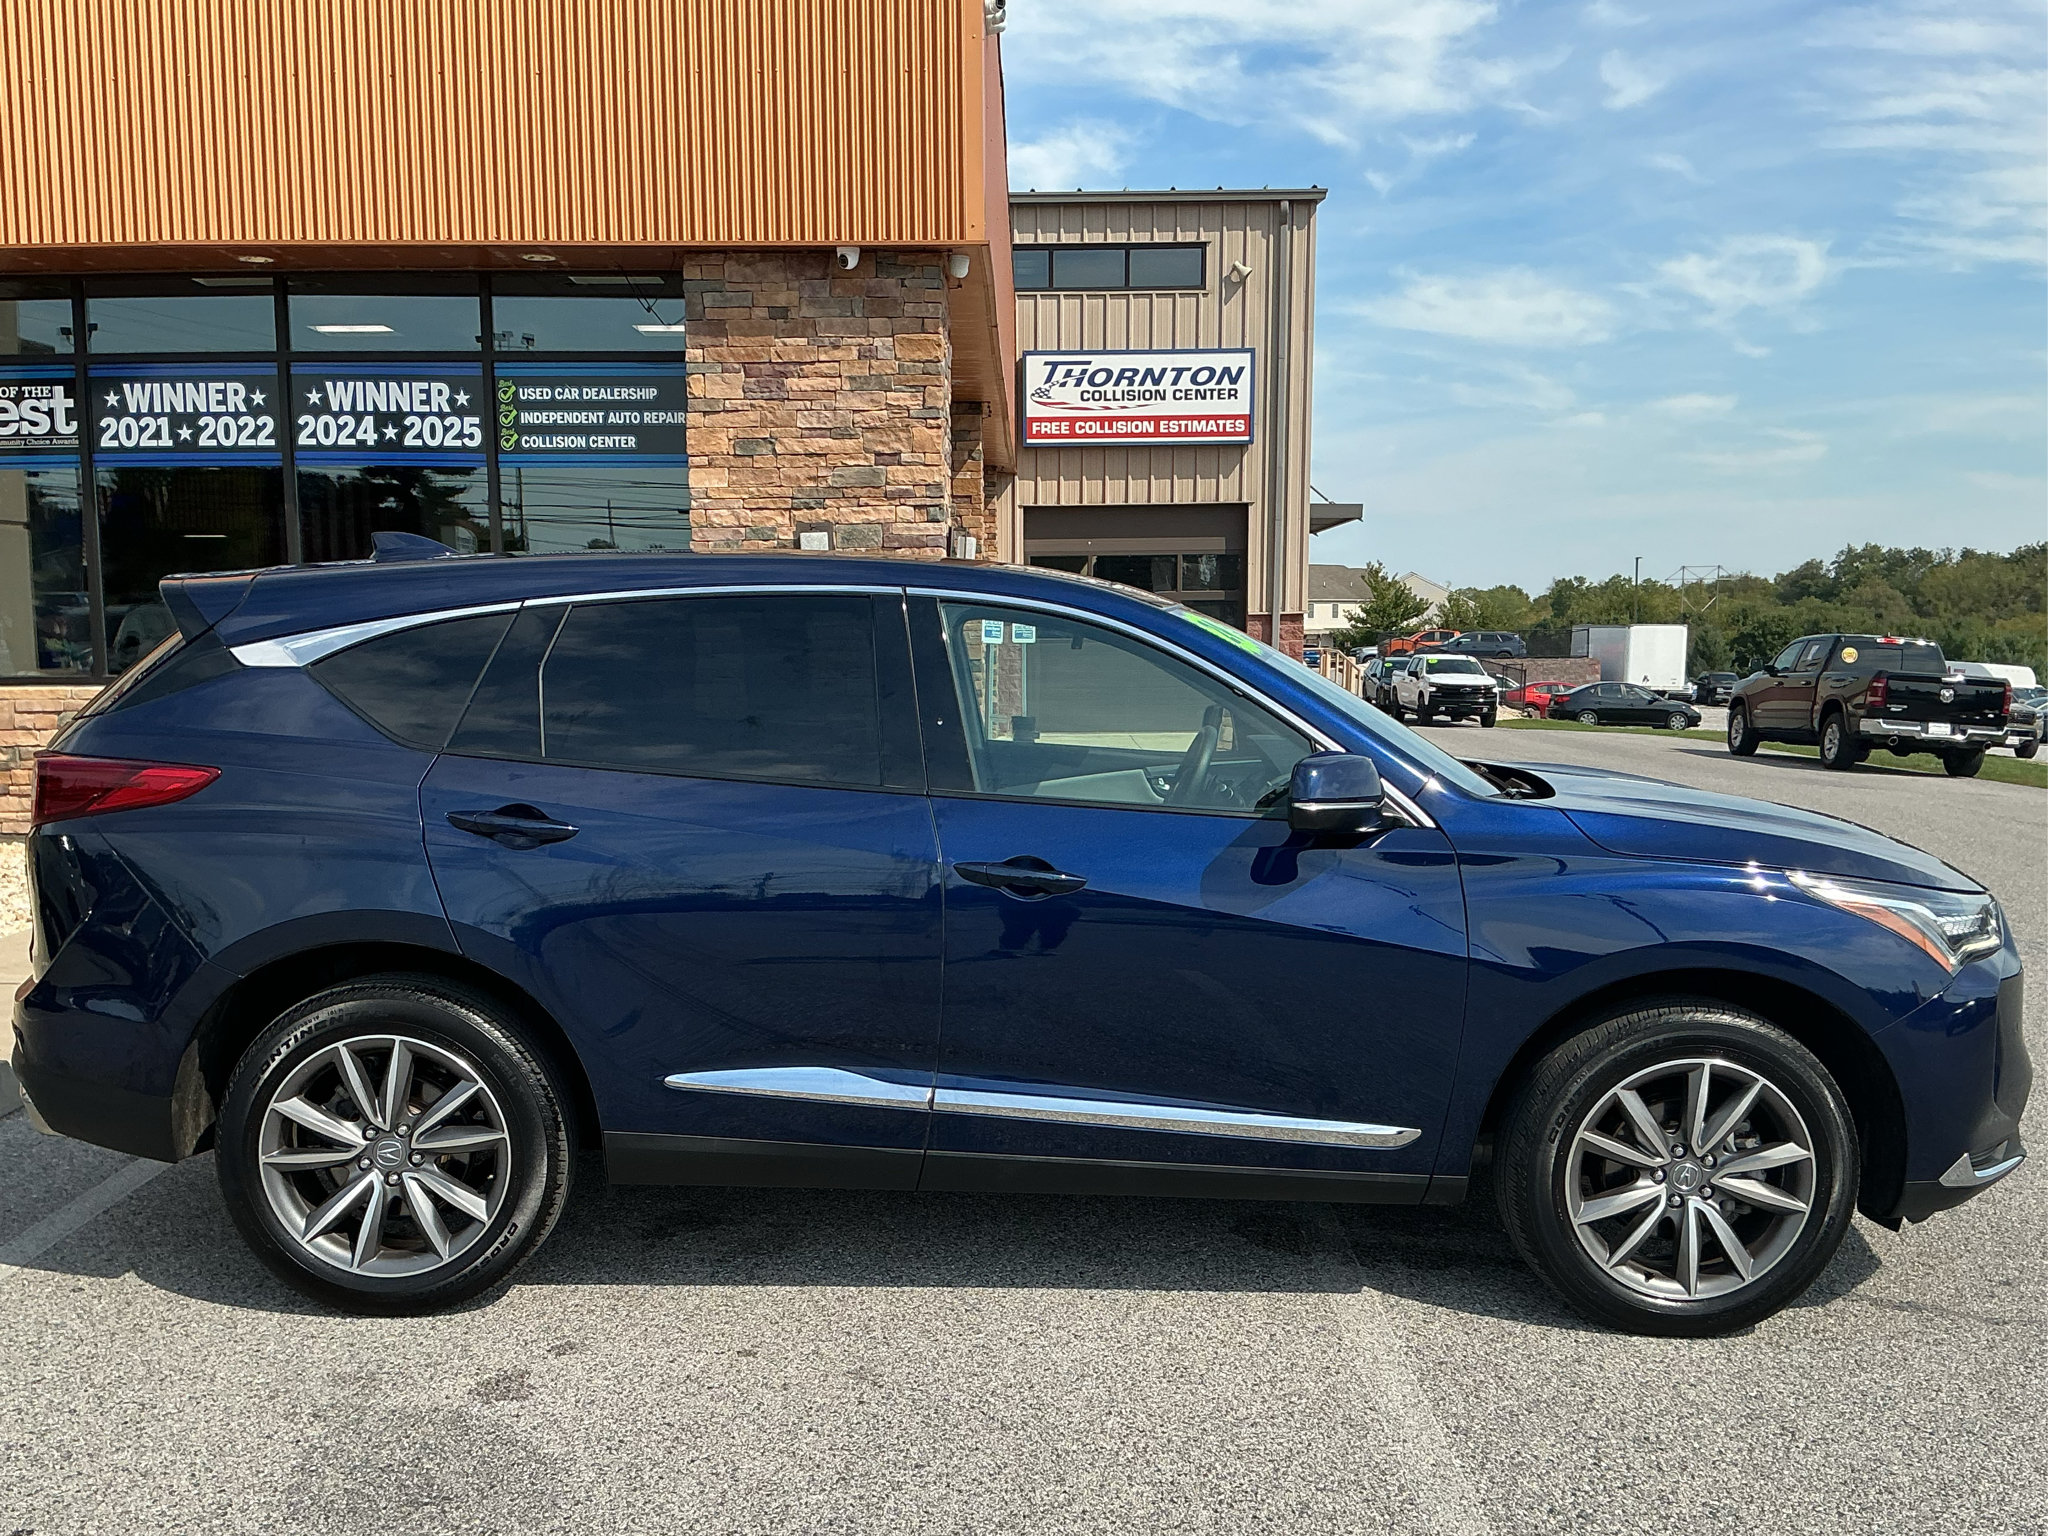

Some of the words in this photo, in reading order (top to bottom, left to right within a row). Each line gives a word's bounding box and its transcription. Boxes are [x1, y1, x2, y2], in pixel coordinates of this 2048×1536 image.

[1043, 360, 1246, 388] THORNTON
[0, 386, 18, 398] OF
[22, 386, 51, 397] THE
[123, 382, 248, 413] WINNER
[325, 381, 452, 413] WINNER
[519, 387, 552, 400] USED
[554, 387, 580, 400] CAR
[582, 387, 658, 400] DEALERSHIP
[1080, 389, 1167, 402] COLLISION
[1172, 387, 1239, 401] CENTER
[520, 411, 605, 424] INDEPENDENT
[607, 411, 641, 424] AUTO
[643, 411, 686, 424] REPAIR
[100, 416, 174, 447] 2021
[198, 415, 275, 446] 2022
[298, 415, 378, 446] 2024
[403, 416, 482, 447] 2025
[1032, 421, 1070, 435] FREE
[1074, 420, 1155, 434] COLLISION
[1159, 419, 1246, 433] ESTIMATES
[521, 435, 586, 448] COLLISION
[589, 435, 636, 448] CENTER
